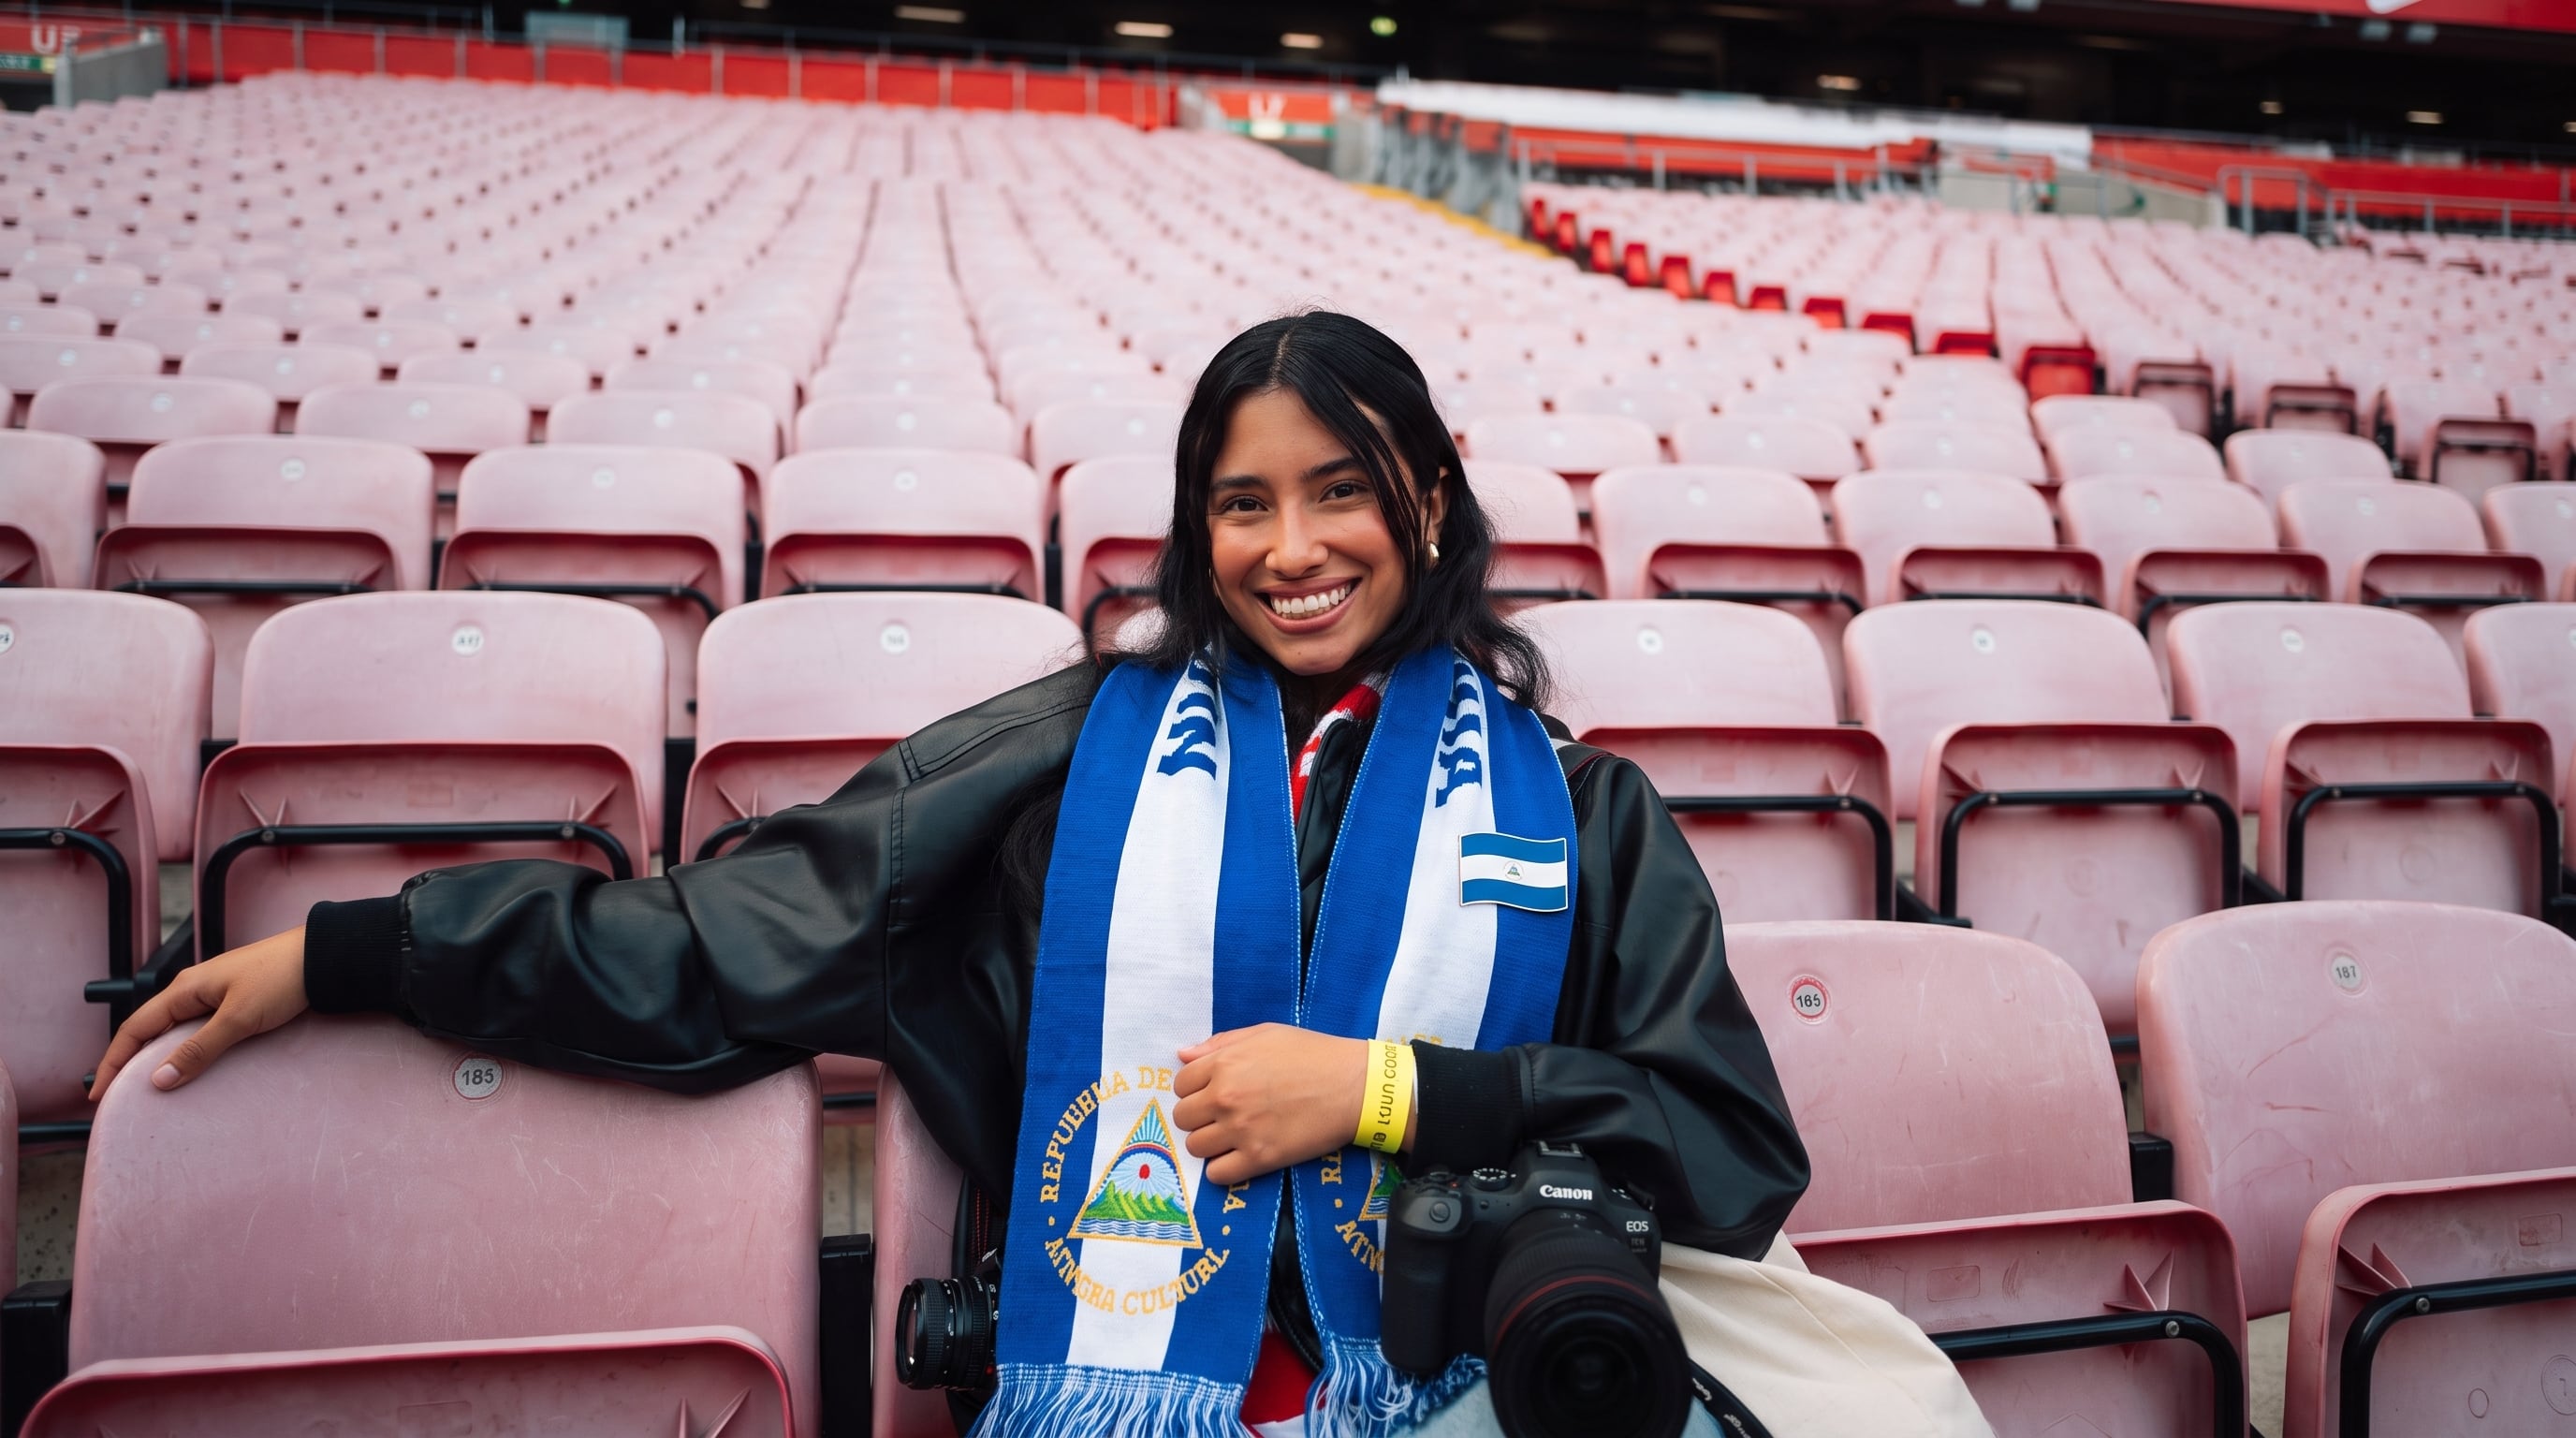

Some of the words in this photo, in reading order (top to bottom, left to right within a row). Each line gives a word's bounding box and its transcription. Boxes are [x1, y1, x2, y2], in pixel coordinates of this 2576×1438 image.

[2335, 965, 2356, 979] 187
[461, 1068, 494, 1086] 185
[1539, 1184, 1593, 1200] Canon
[1625, 1221, 1649, 1233] EOS
